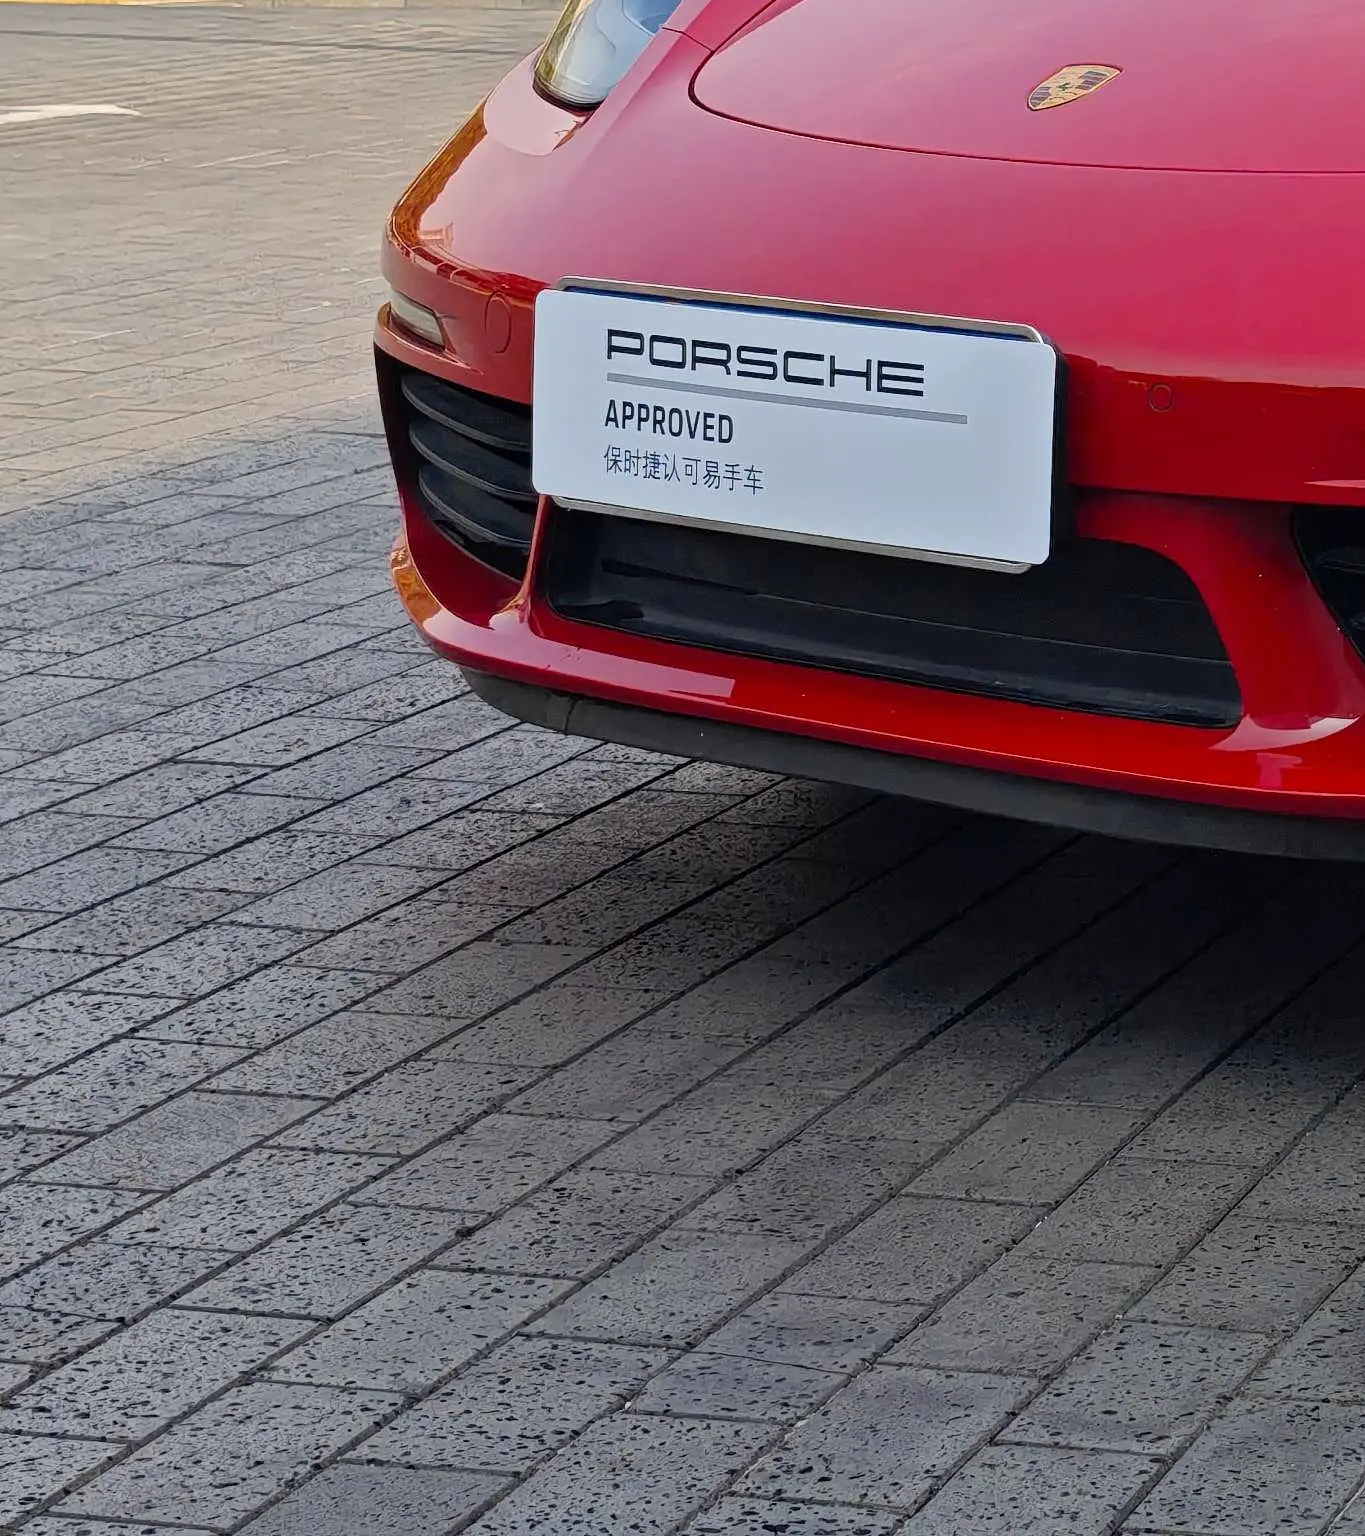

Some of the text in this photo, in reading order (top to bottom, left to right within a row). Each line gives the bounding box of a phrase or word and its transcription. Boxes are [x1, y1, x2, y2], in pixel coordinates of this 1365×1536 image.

[606, 328, 925, 398] PORSCHE
[604, 399, 734, 445] APPROVED
[603, 444, 764, 496] 保时捷认可易手车
